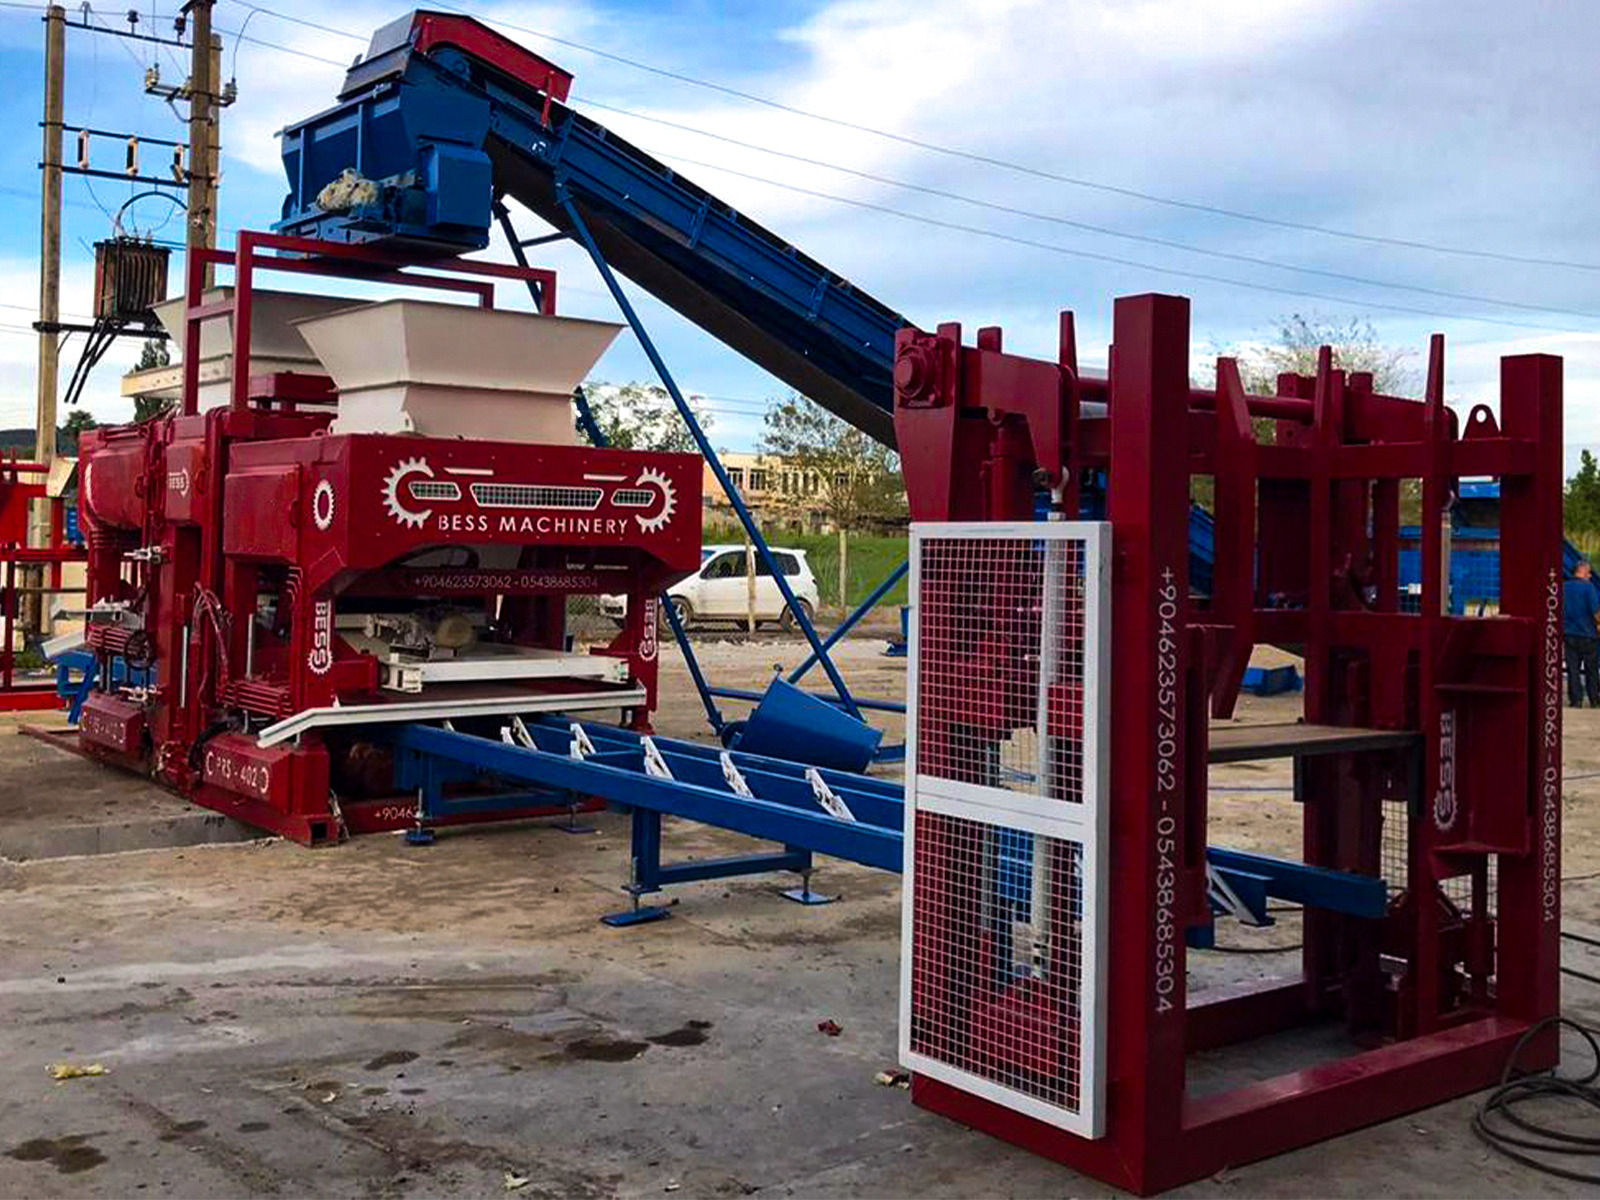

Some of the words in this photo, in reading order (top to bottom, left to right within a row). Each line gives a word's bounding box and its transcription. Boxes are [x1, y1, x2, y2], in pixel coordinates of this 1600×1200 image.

[438, 515, 488, 532] BESS
[499, 516, 629, 534] MACHINERY
[314, 602, 327, 665] BESS
[1158, 565, 1176, 792] +904623573062
[1440, 713, 1452, 816] BESS
[1156, 816, 1176, 1014] 05438685304
